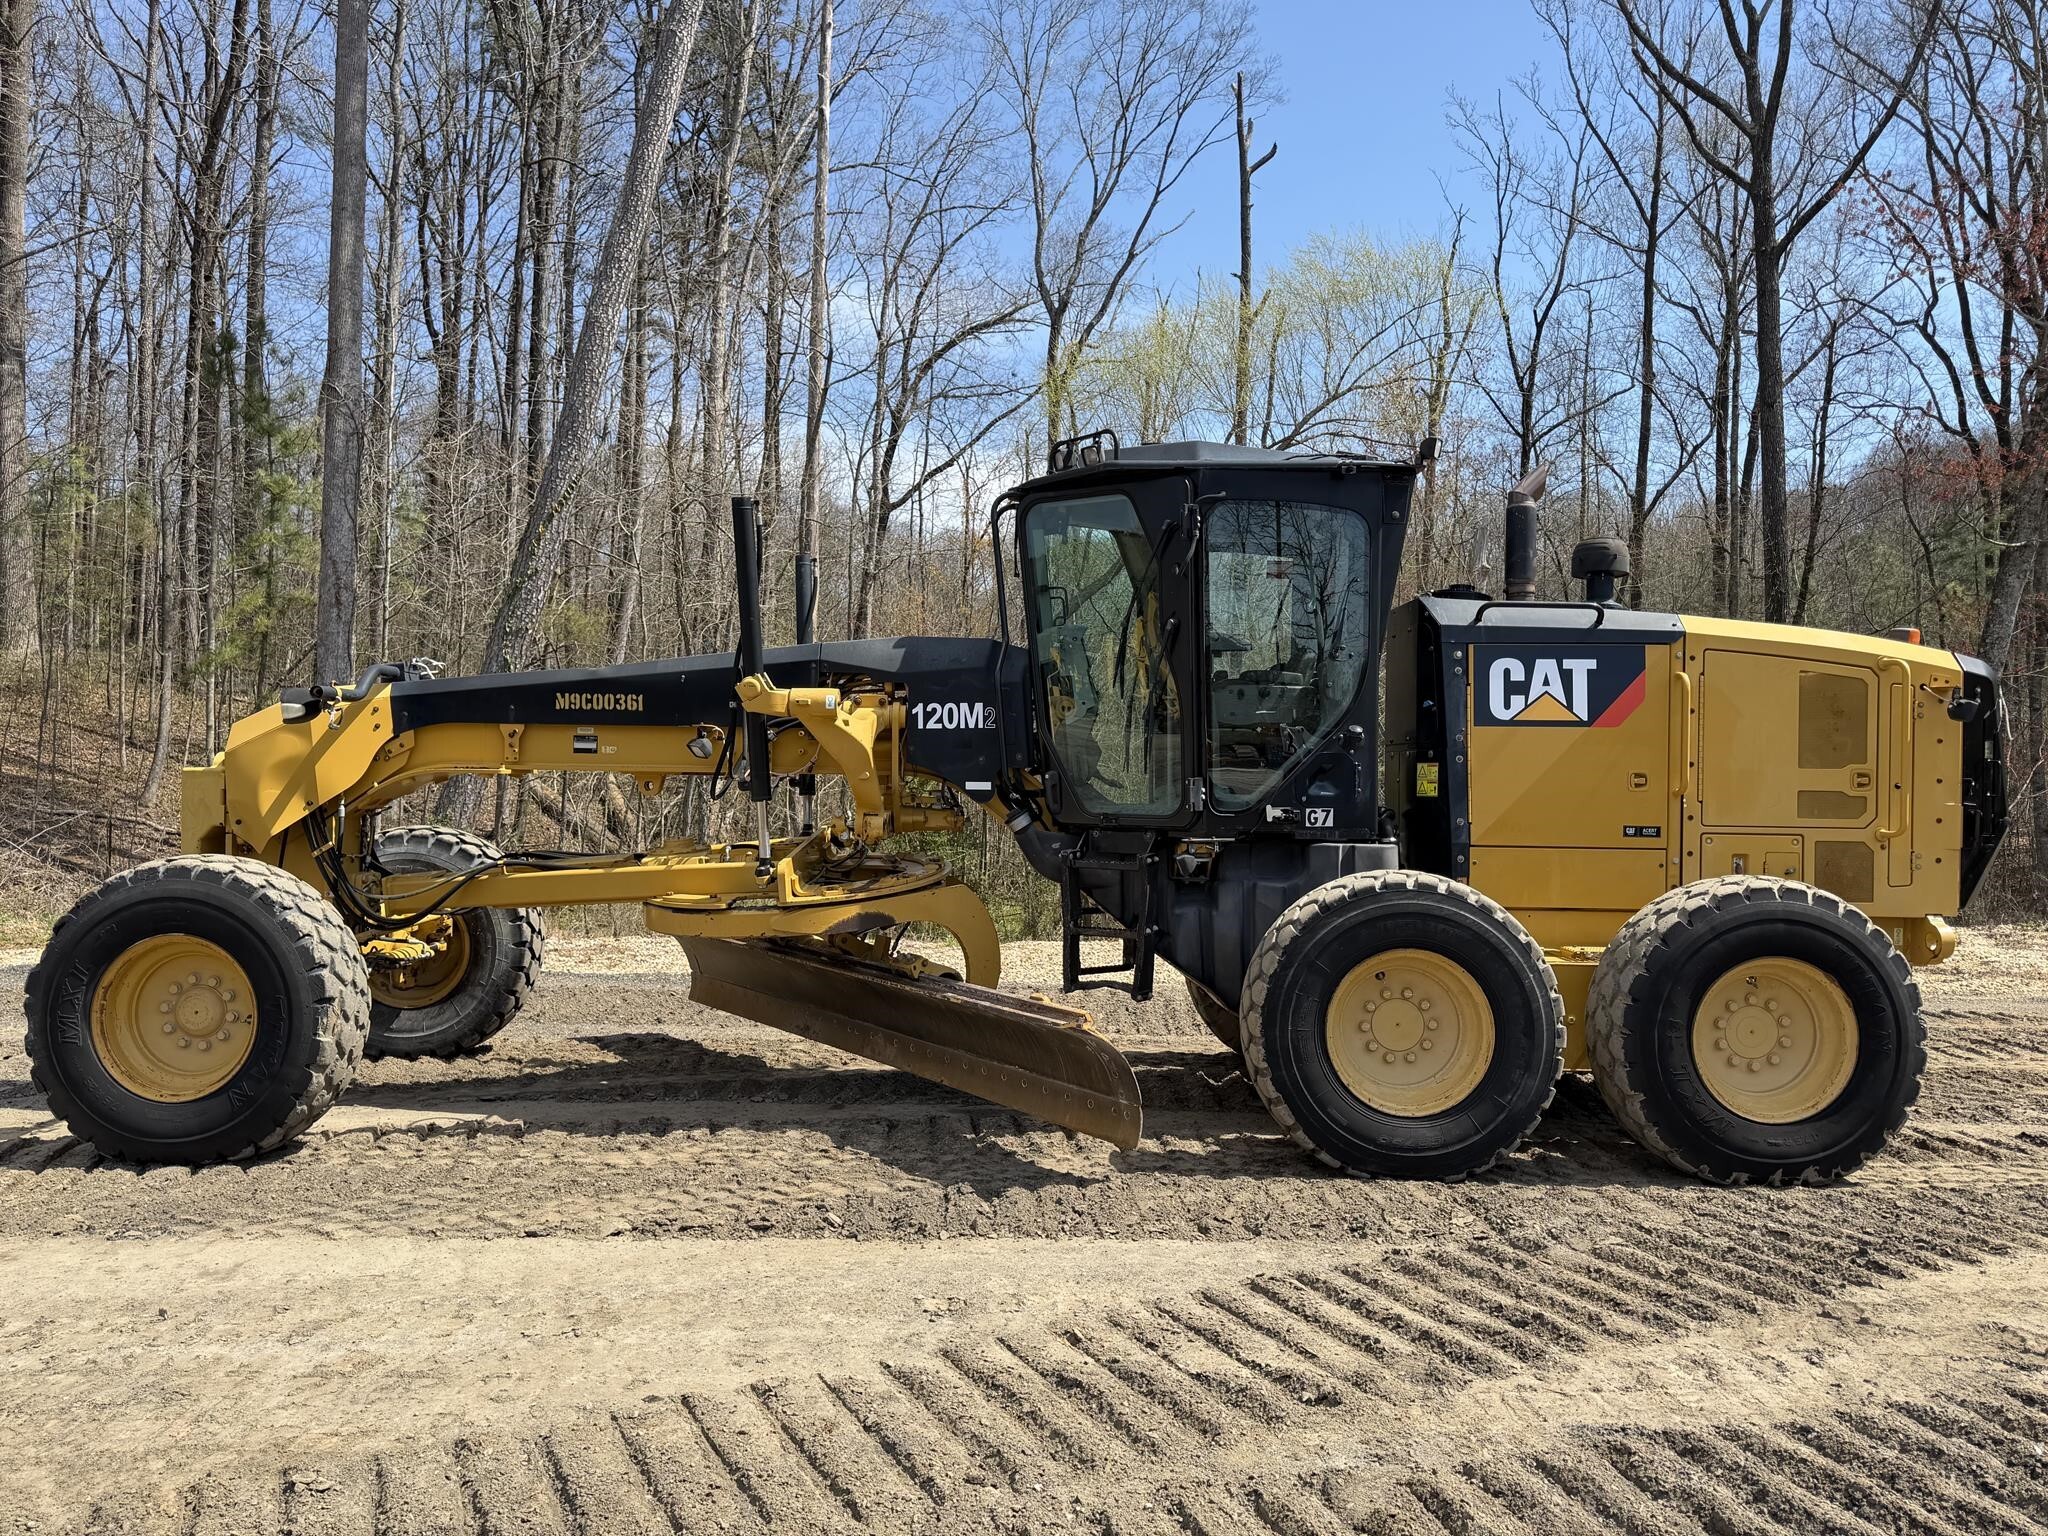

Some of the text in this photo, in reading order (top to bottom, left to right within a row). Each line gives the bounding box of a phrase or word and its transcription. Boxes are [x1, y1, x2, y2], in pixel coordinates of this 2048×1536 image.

[1489, 657, 1598, 721] CAT
[555, 692, 644, 712] M9C00361
[1307, 809, 1332, 826] G7
